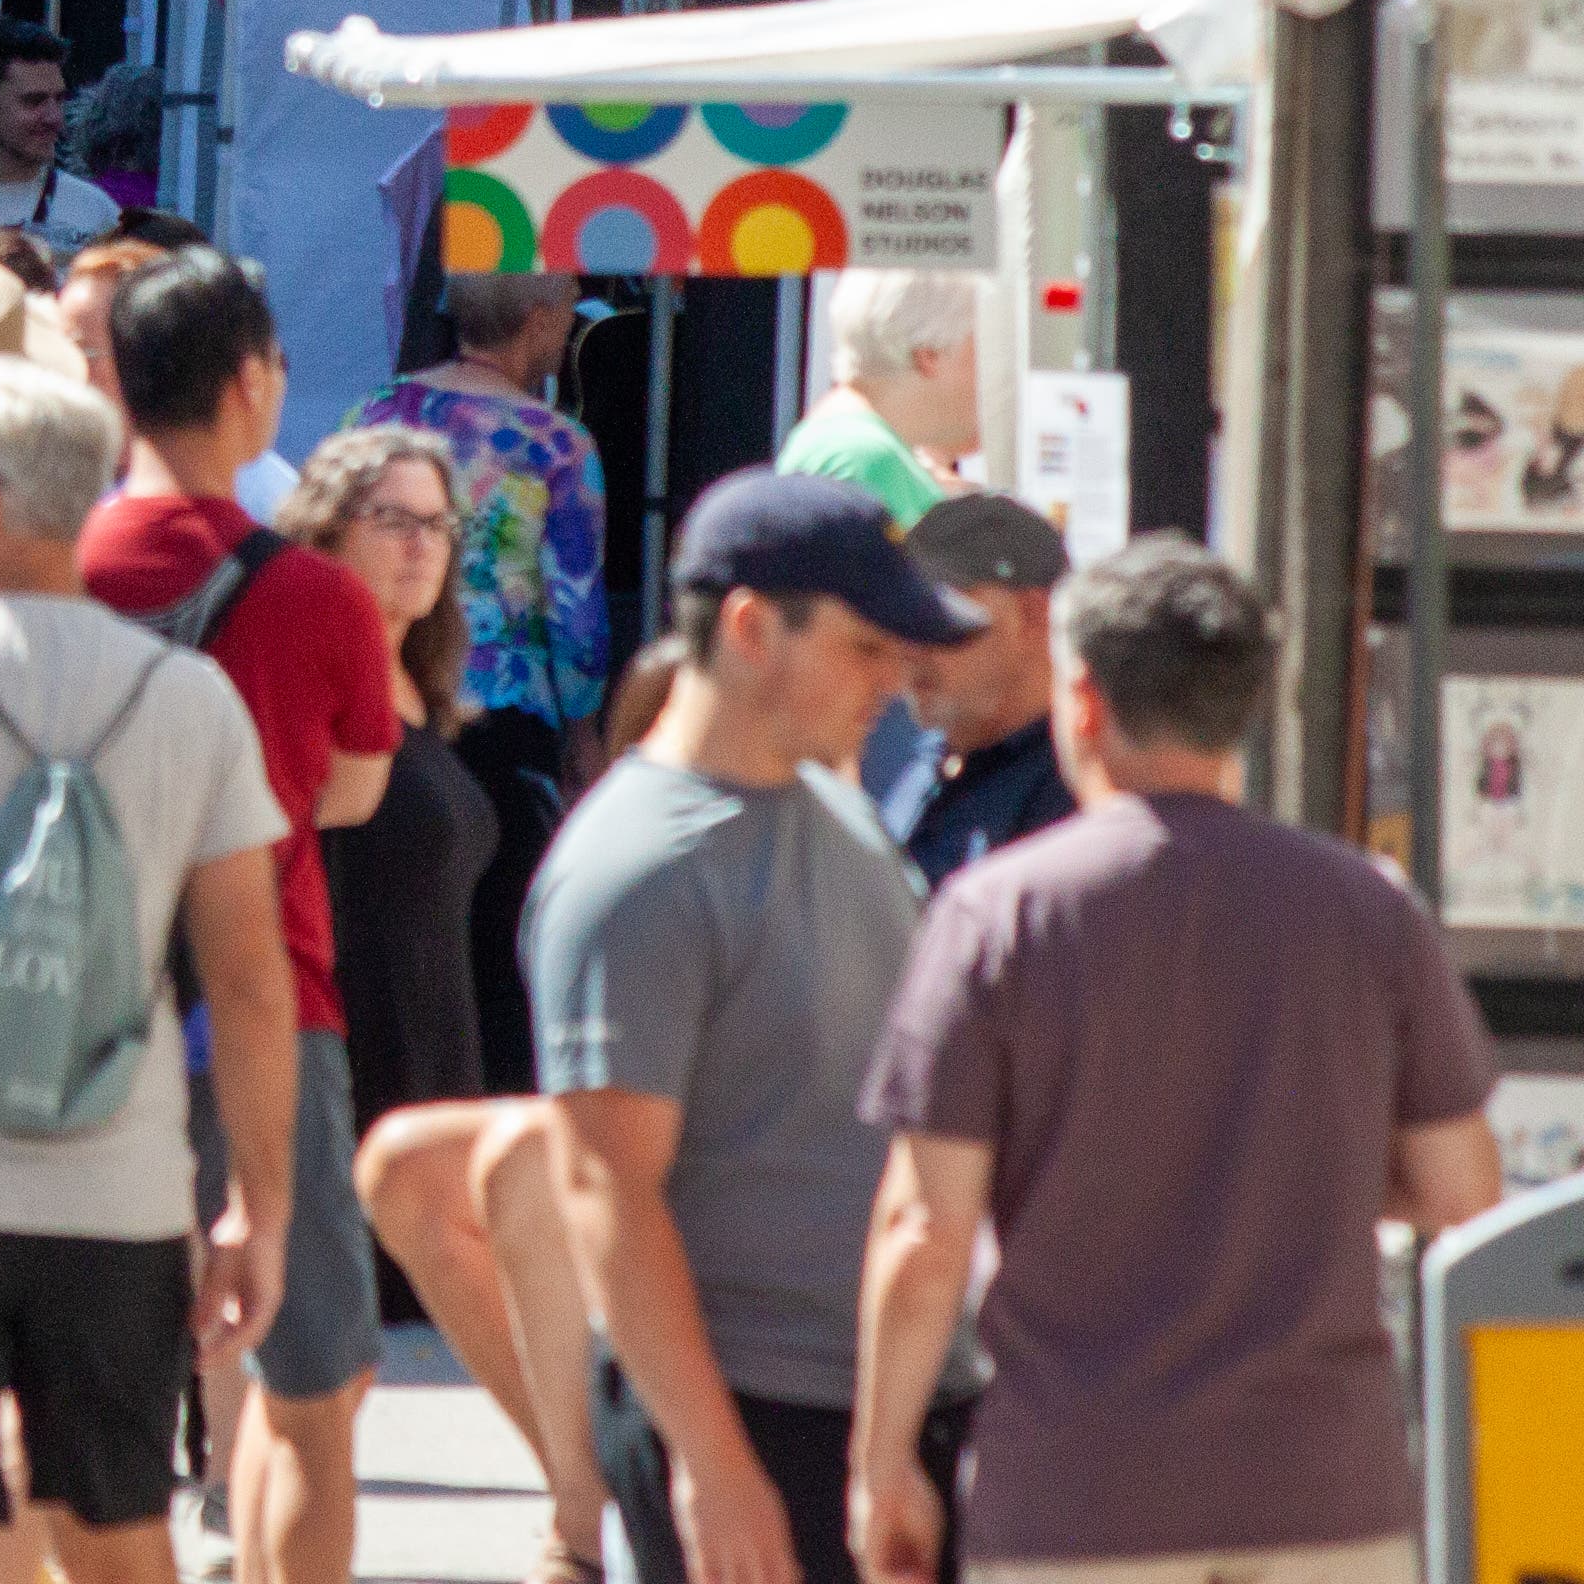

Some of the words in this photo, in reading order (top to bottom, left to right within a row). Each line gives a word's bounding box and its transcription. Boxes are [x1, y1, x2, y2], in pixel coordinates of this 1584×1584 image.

[861, 169, 988, 192] DOUGLAS
[861, 202, 971, 223] NELSON
[861, 234, 974, 256] STUDIOS
